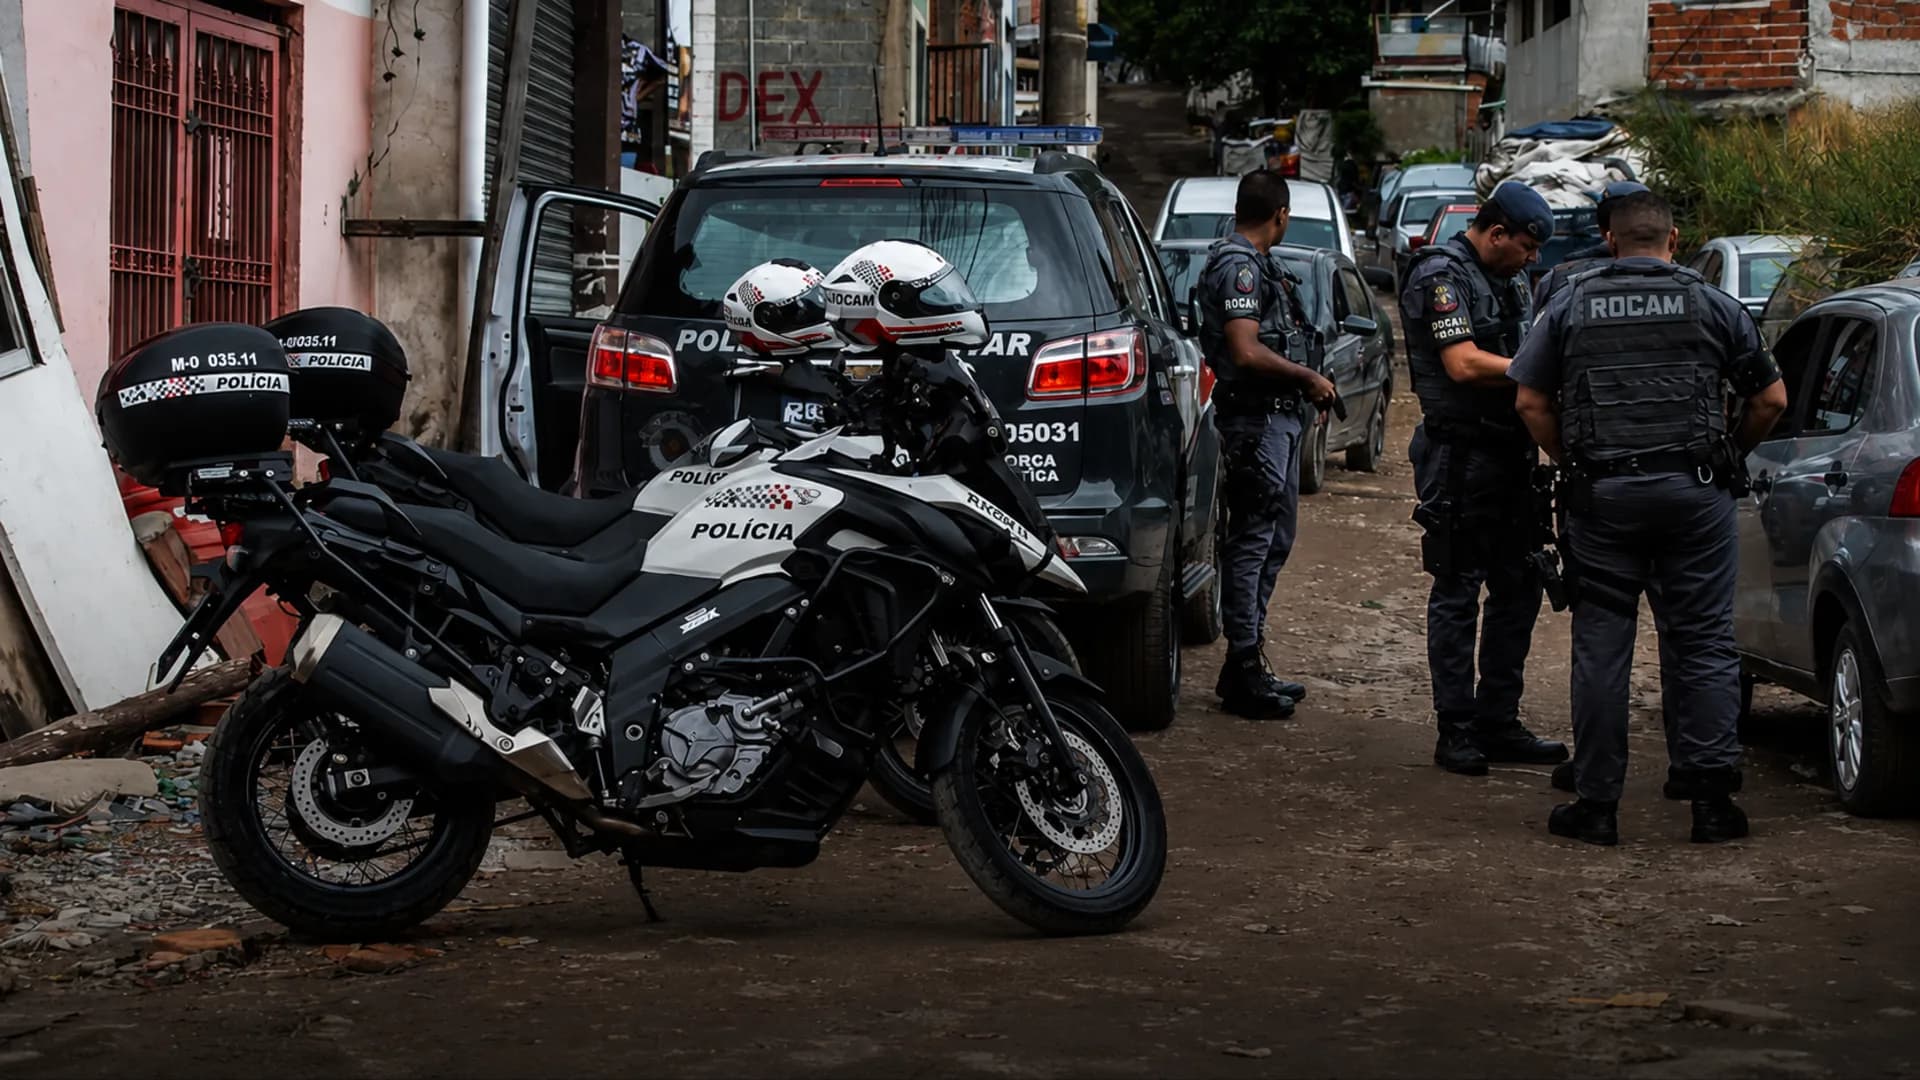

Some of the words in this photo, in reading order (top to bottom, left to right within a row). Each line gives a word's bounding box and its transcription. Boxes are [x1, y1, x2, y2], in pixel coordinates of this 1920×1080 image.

[718, 70, 824, 126] DEX
[1225, 298, 1259, 311] ROCAM
[1590, 294, 1685, 319] ROCAM
[171, 356, 200, 372] M-0
[208, 352, 257, 367] 035.11
[216, 373, 282, 390] POLÍCIA
[691, 518, 794, 541] POLÍCIA
